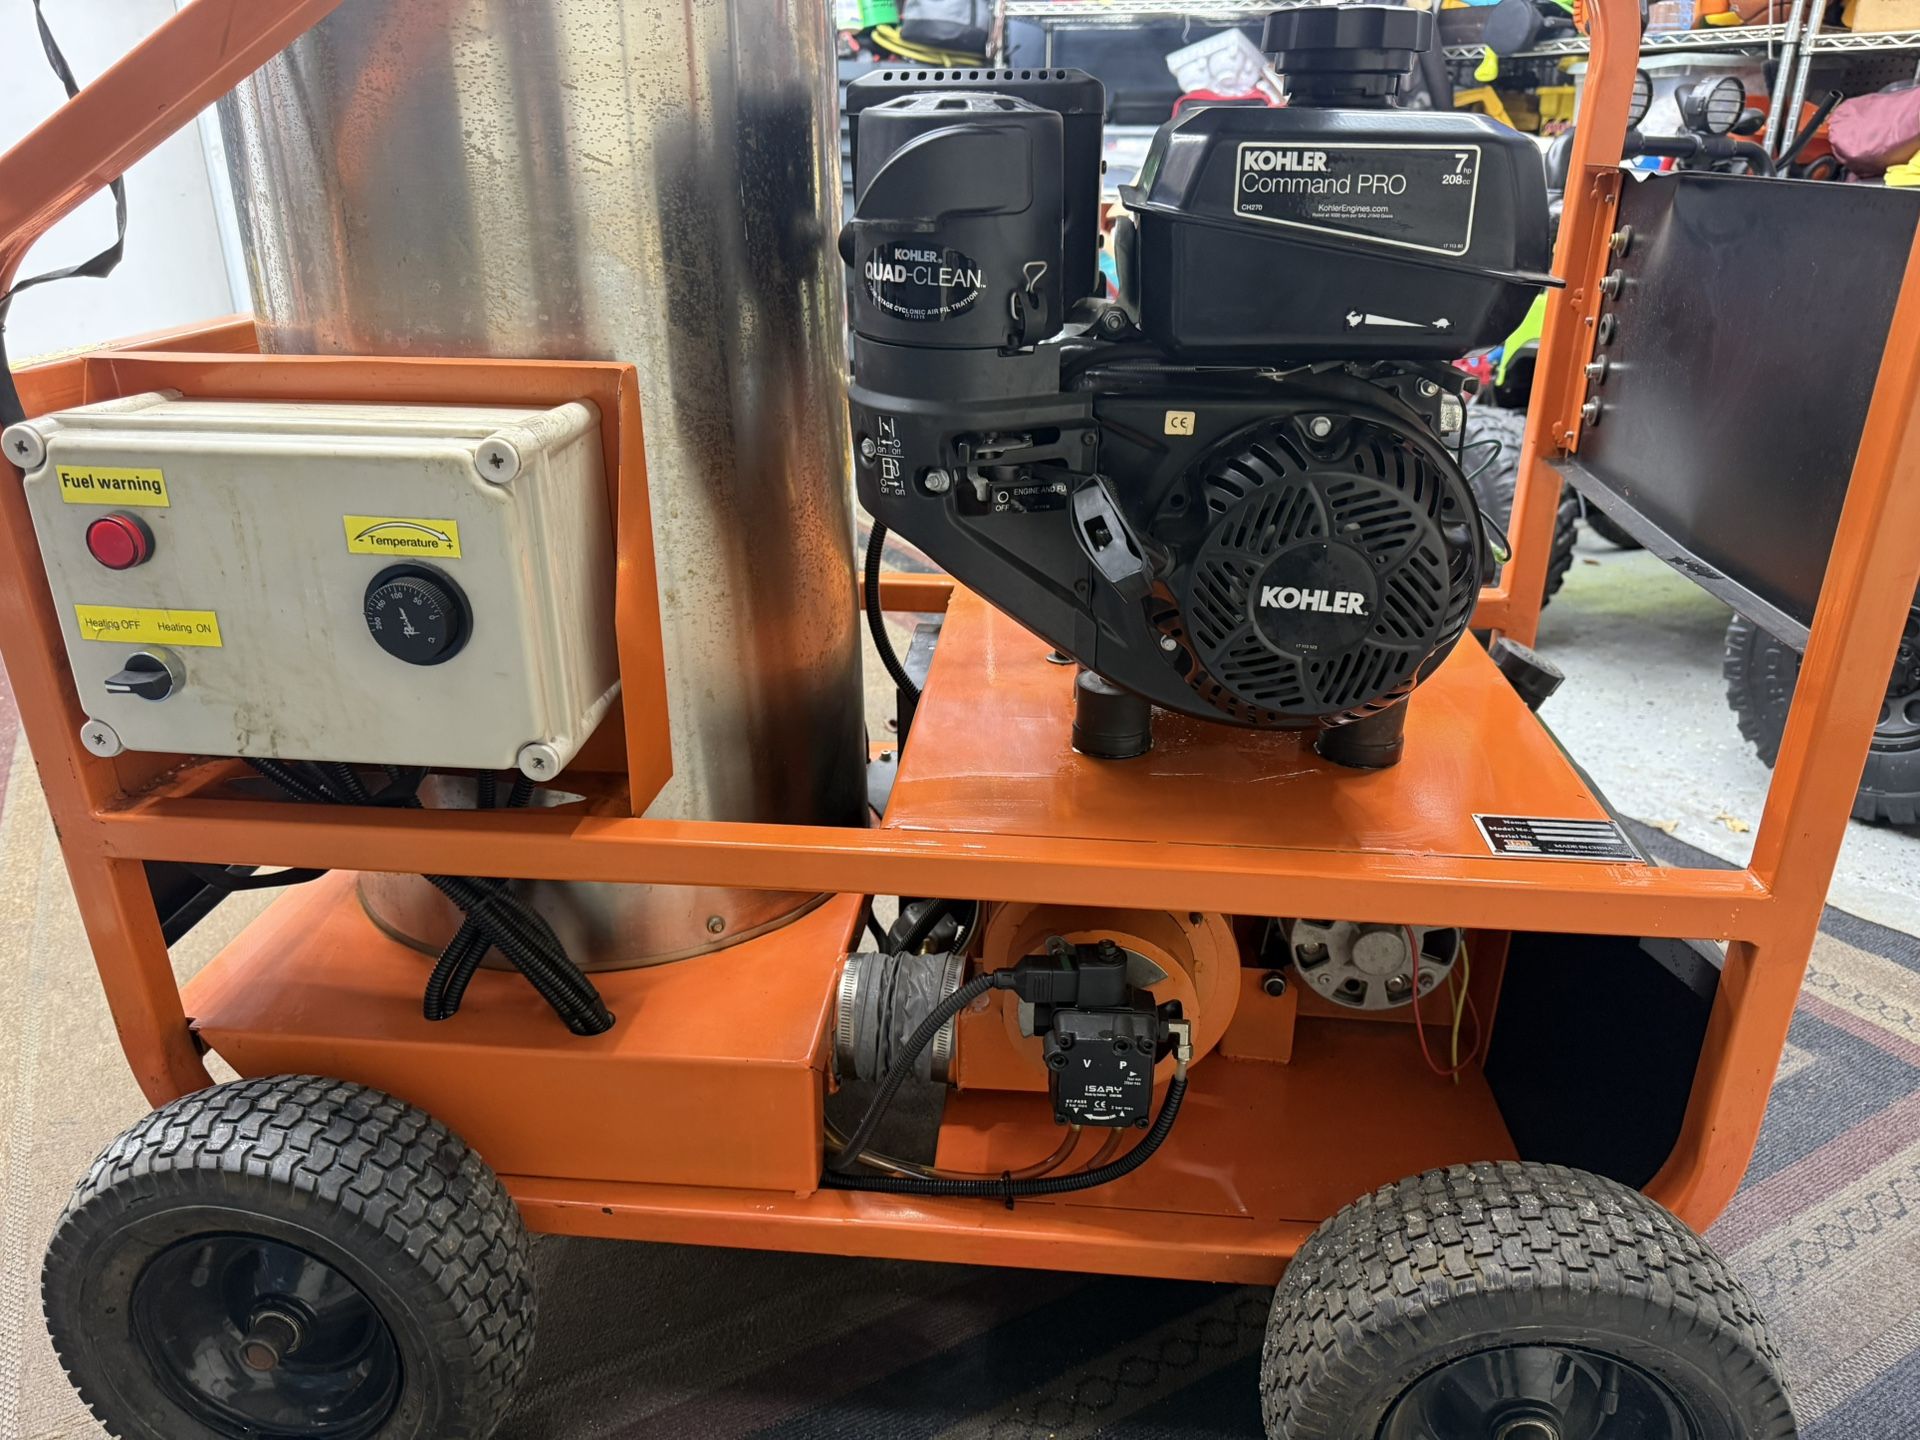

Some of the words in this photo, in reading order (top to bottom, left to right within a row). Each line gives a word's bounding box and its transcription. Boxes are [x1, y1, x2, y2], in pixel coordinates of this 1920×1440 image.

[1244, 151, 1328, 172] KOHLER
[1242, 172, 1351, 194] Command
[1357, 174, 1407, 195] PRO
[1318, 204, 1389, 213] KohlerEngines.com
[895, 248, 937, 263] KOHLER
[865, 261, 982, 288] QUAD-CLEAN
[894, 305, 926, 315] CYCLONIC
[62, 473, 95, 489] Fuel
[97, 476, 162, 495] warning
[1013, 487, 1040, 496] ENGINE
[996, 504, 1009, 512] OFF
[368, 535, 439, 548] Temperature
[1260, 585, 1365, 615] KOHLER
[84, 618, 120, 630] Heating
[121, 620, 140, 629] OFF
[157, 622, 192, 633] Heating
[196, 624, 211, 633] ON
[1083, 1059, 1092, 1068] V
[1119, 1061, 1127, 1069] P
[1085, 1085, 1122, 1094] ISARY
